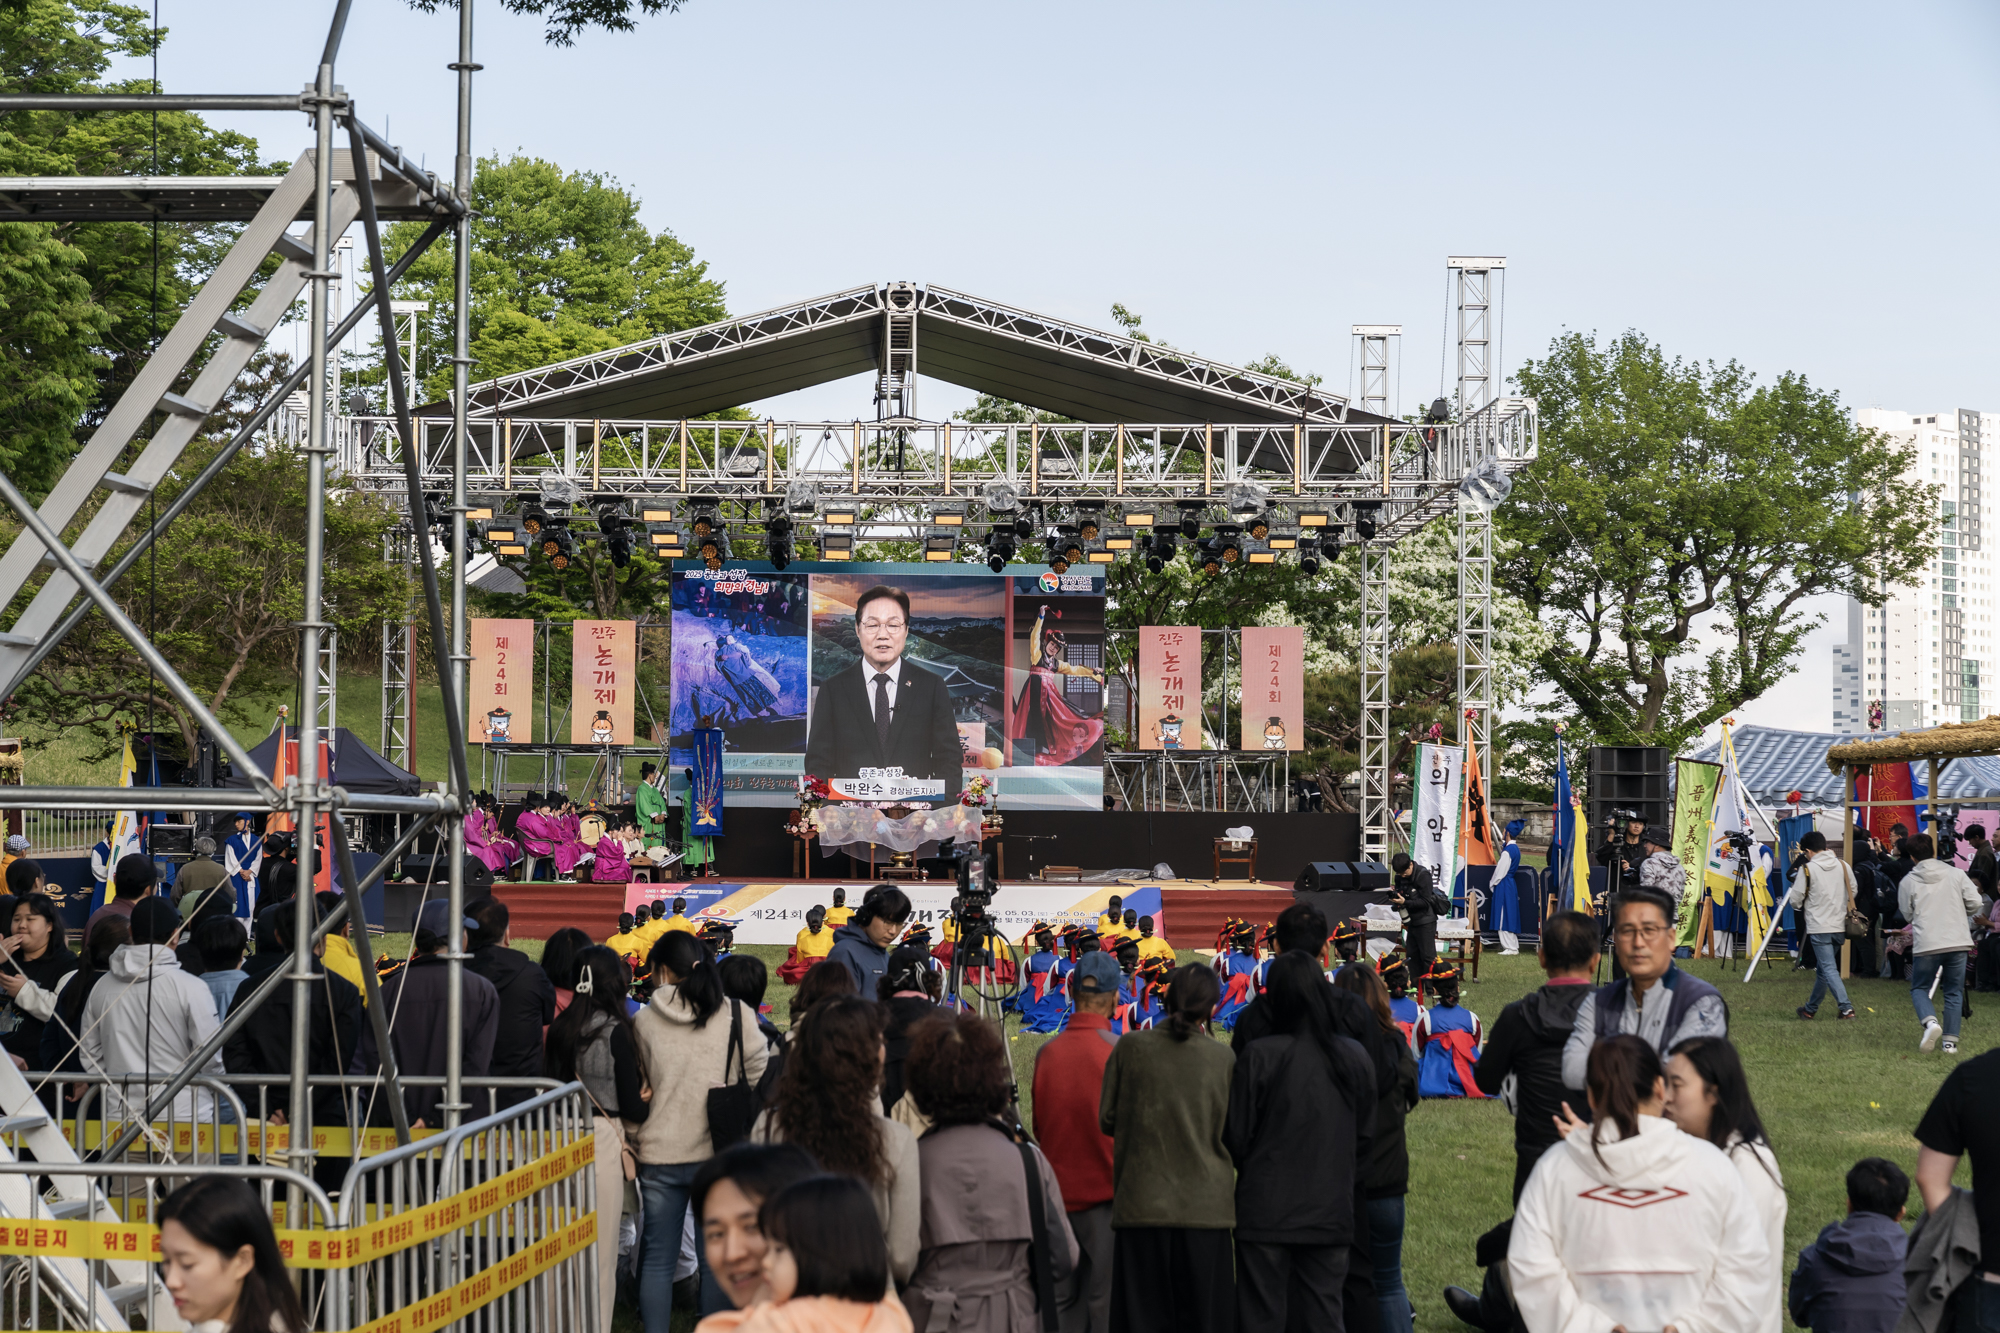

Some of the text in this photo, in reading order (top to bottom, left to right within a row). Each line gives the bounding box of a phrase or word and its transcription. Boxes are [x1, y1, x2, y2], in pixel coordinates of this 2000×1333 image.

[685, 570, 702, 578] 2025
[729, 569, 747, 580] 성장
[1061, 576, 1092, 585] 경상남도
[714, 580, 769, 595] 희망의 경남!
[591, 627, 616, 640] 진주
[1158, 632, 1184, 646] 진주
[494, 636, 509, 696] 제24회
[592, 644, 616, 705] 논개제
[1160, 650, 1184, 711] 논개제
[1268, 644, 1282, 704] 제24회
[859, 767, 903, 778] 공존과 성장
[844, 783, 936, 796] 박완수 경상남도지사
[750, 908, 802, 920] 제24회
[103, 1231, 138, 1251] 위험
[308, 1236, 360, 1260] 출입금지
